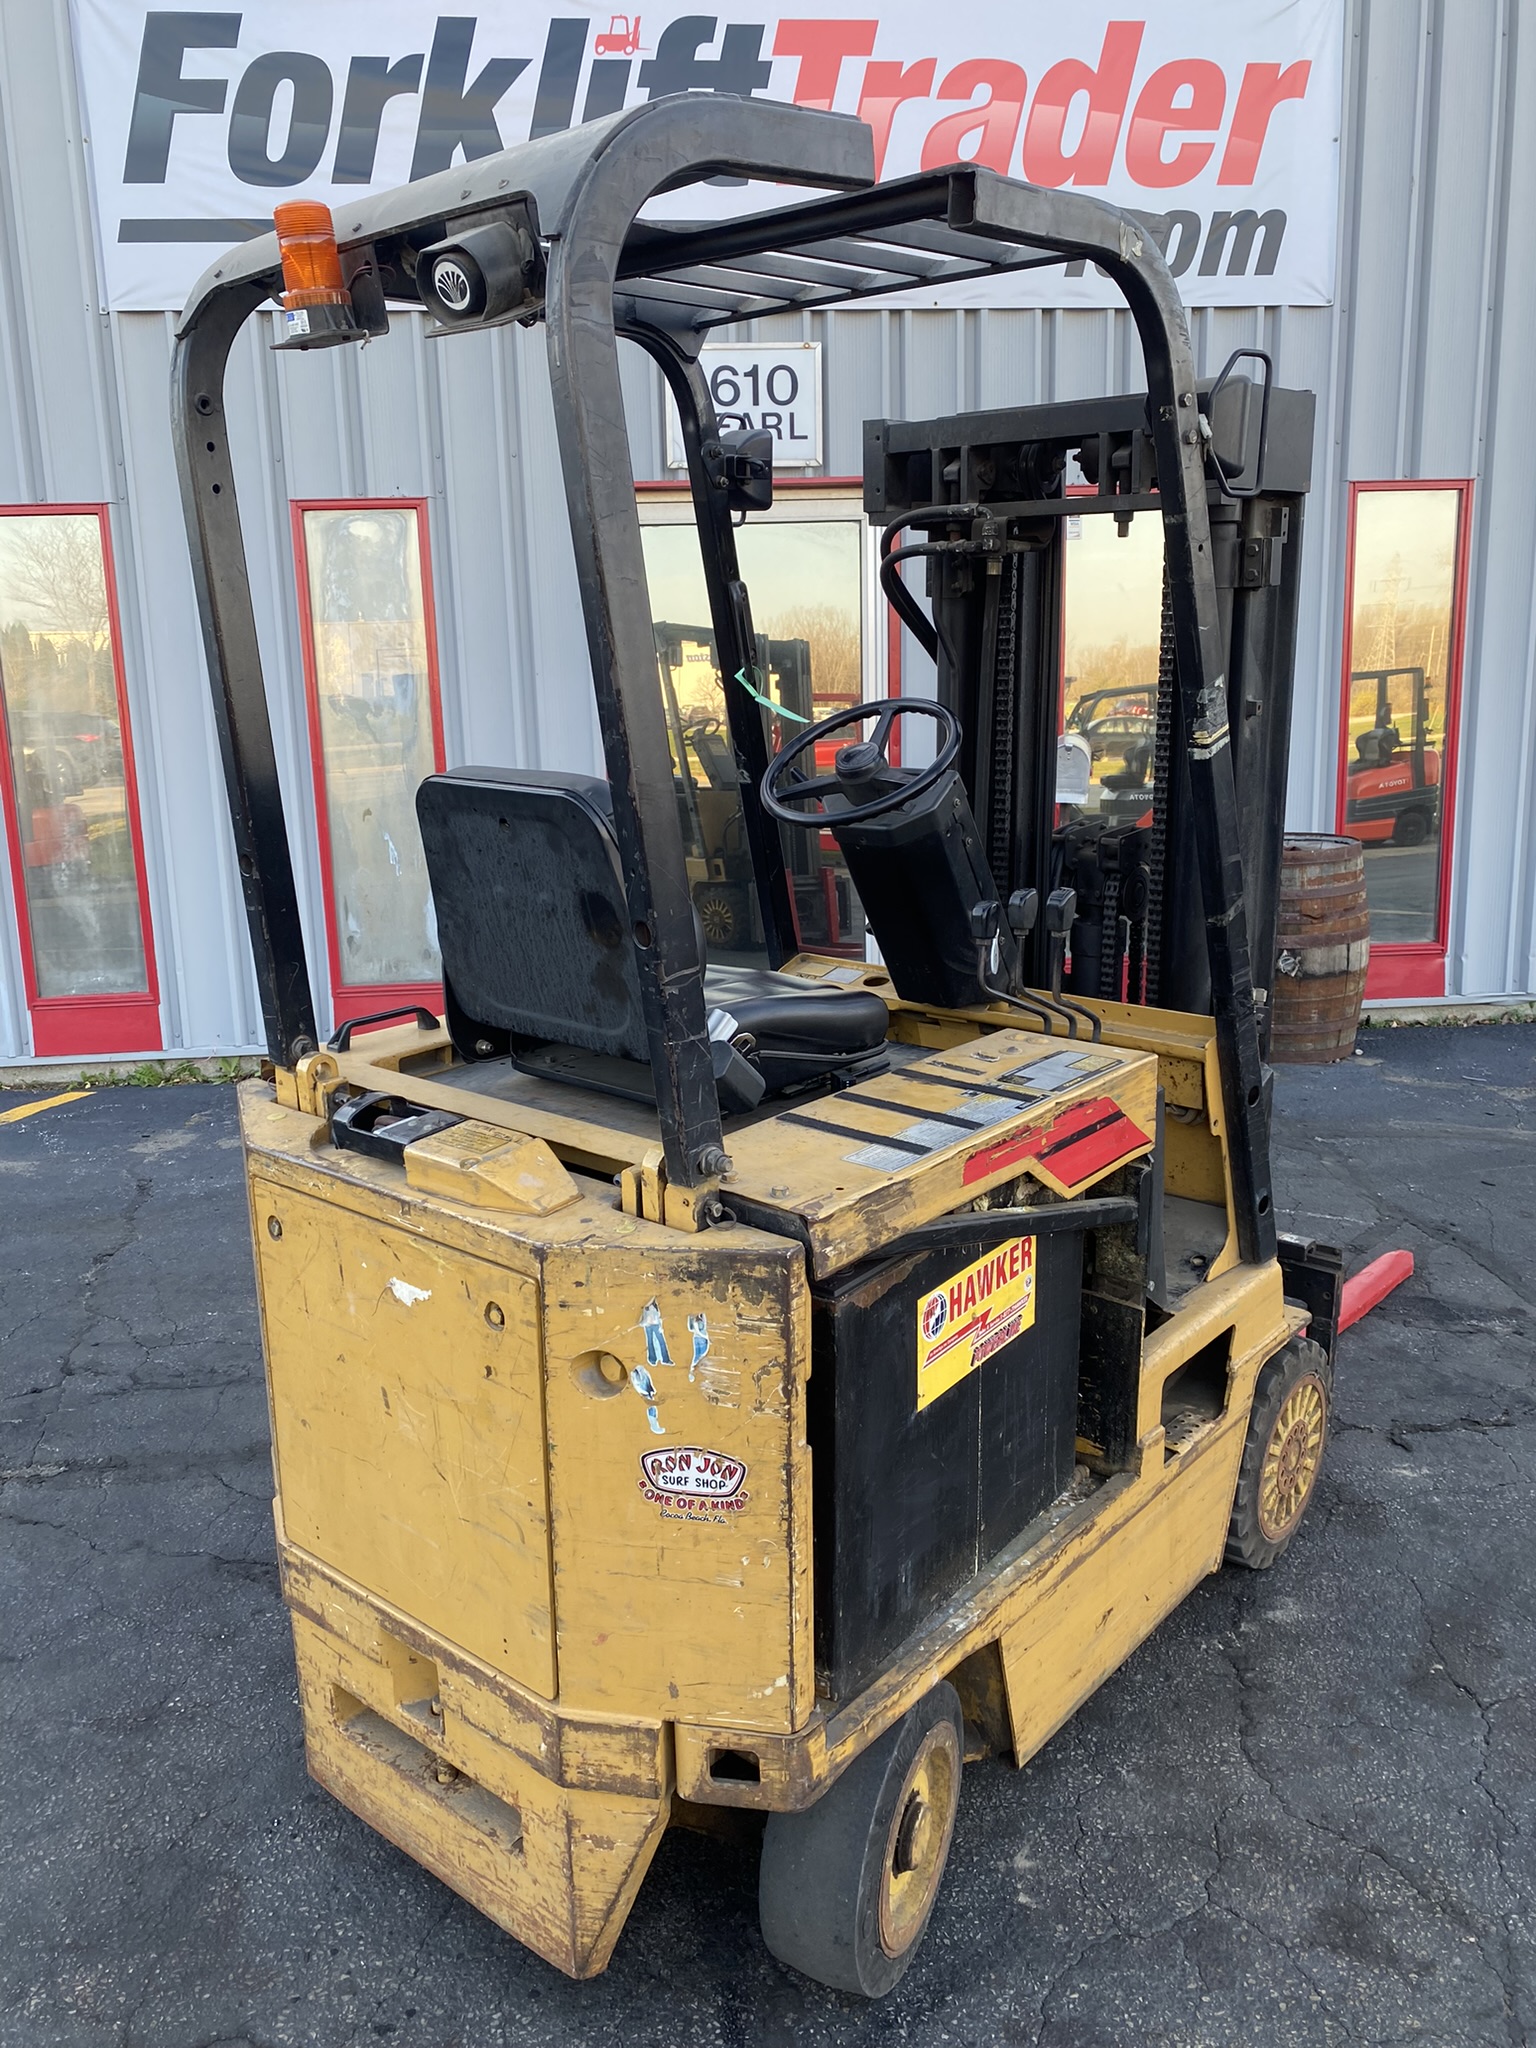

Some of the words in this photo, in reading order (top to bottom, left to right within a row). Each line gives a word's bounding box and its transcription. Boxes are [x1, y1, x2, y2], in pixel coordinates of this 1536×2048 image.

[1064, 208, 1287, 278] .om
[949, 1236, 1032, 1323] HAWKER
[651, 1454, 691, 1476] RON
[696, 1458, 738, 1481] JON
[662, 1475, 689, 1486] SURF
[695, 1478, 726, 1490] SHOP
[676, 1498, 695, 1510] OF
[699, 1501, 708, 1511] A
